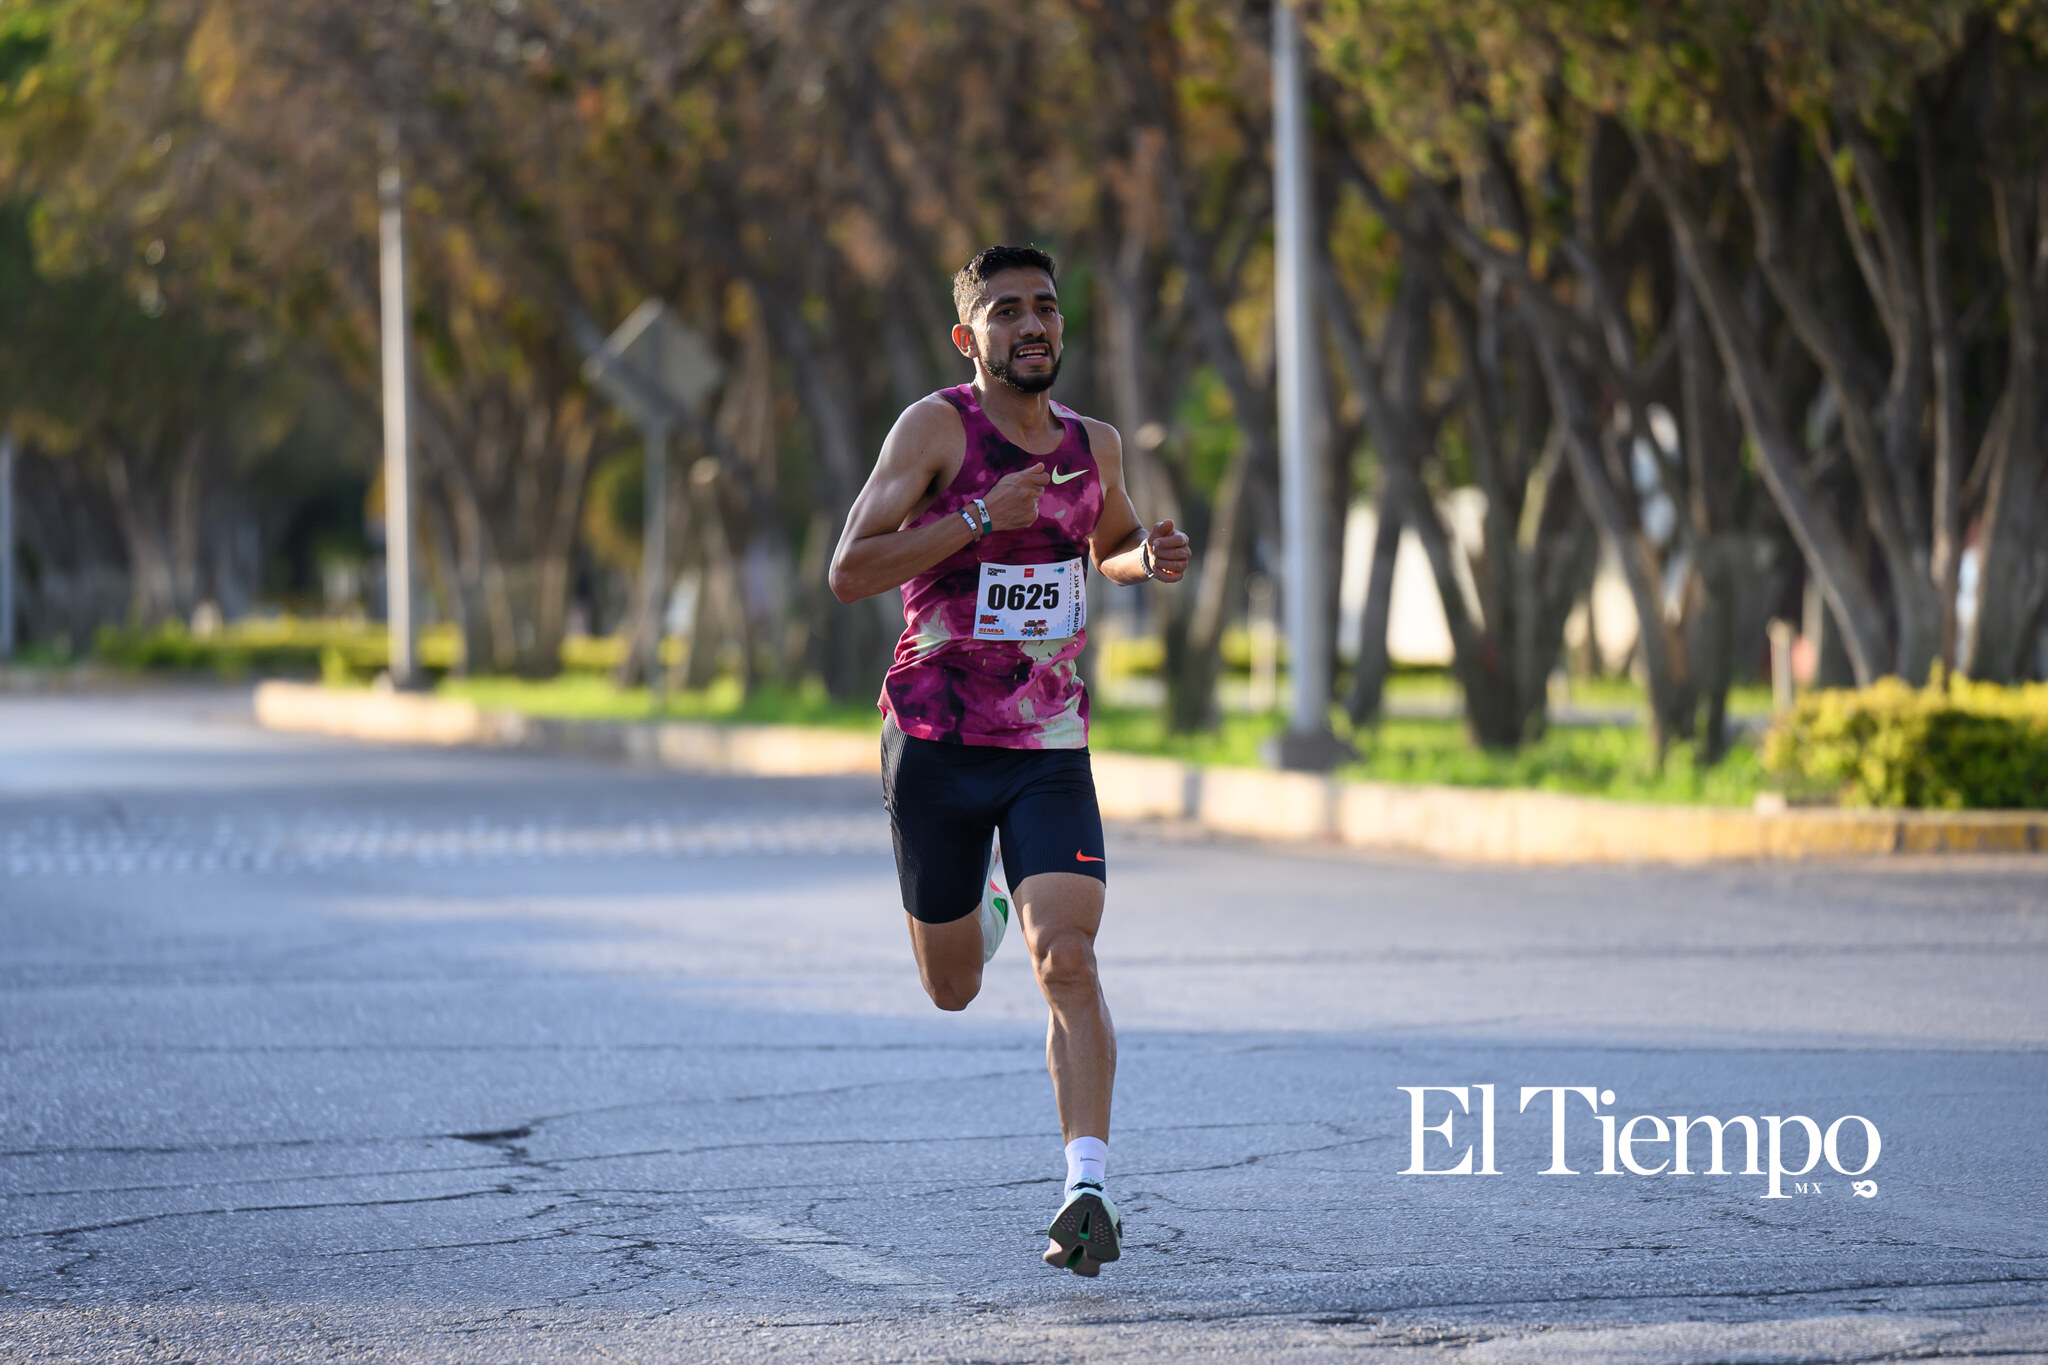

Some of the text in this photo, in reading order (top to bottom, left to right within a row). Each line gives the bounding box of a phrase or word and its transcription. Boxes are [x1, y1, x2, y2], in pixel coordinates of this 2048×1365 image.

[987, 582, 1059, 610] 0625
[1074, 590, 1079, 600] de
[1072, 602, 1080, 633] Entrega
